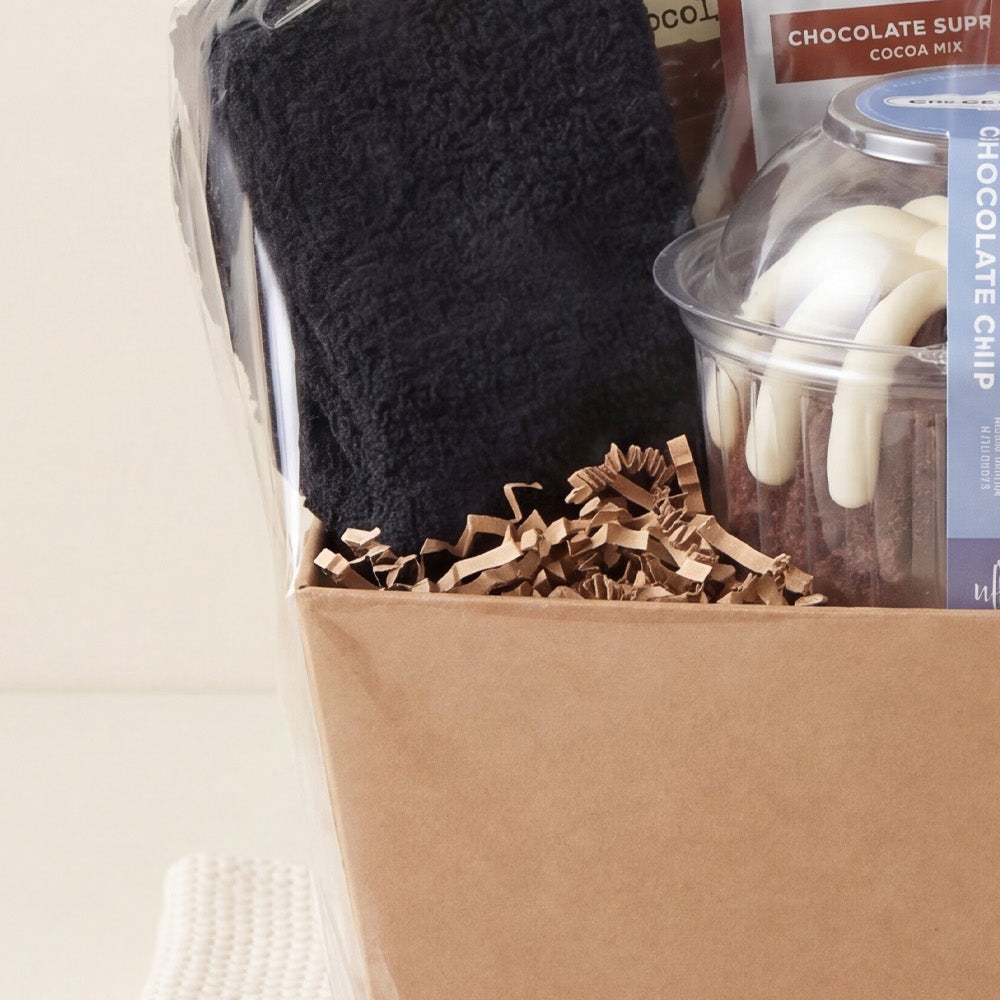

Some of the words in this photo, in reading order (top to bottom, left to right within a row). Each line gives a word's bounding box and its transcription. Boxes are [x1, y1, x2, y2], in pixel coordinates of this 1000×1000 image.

[788, 19, 927, 47] CHOCOLATE
[869, 46, 929, 62] COCOA
[934, 41, 963, 55] MIX
